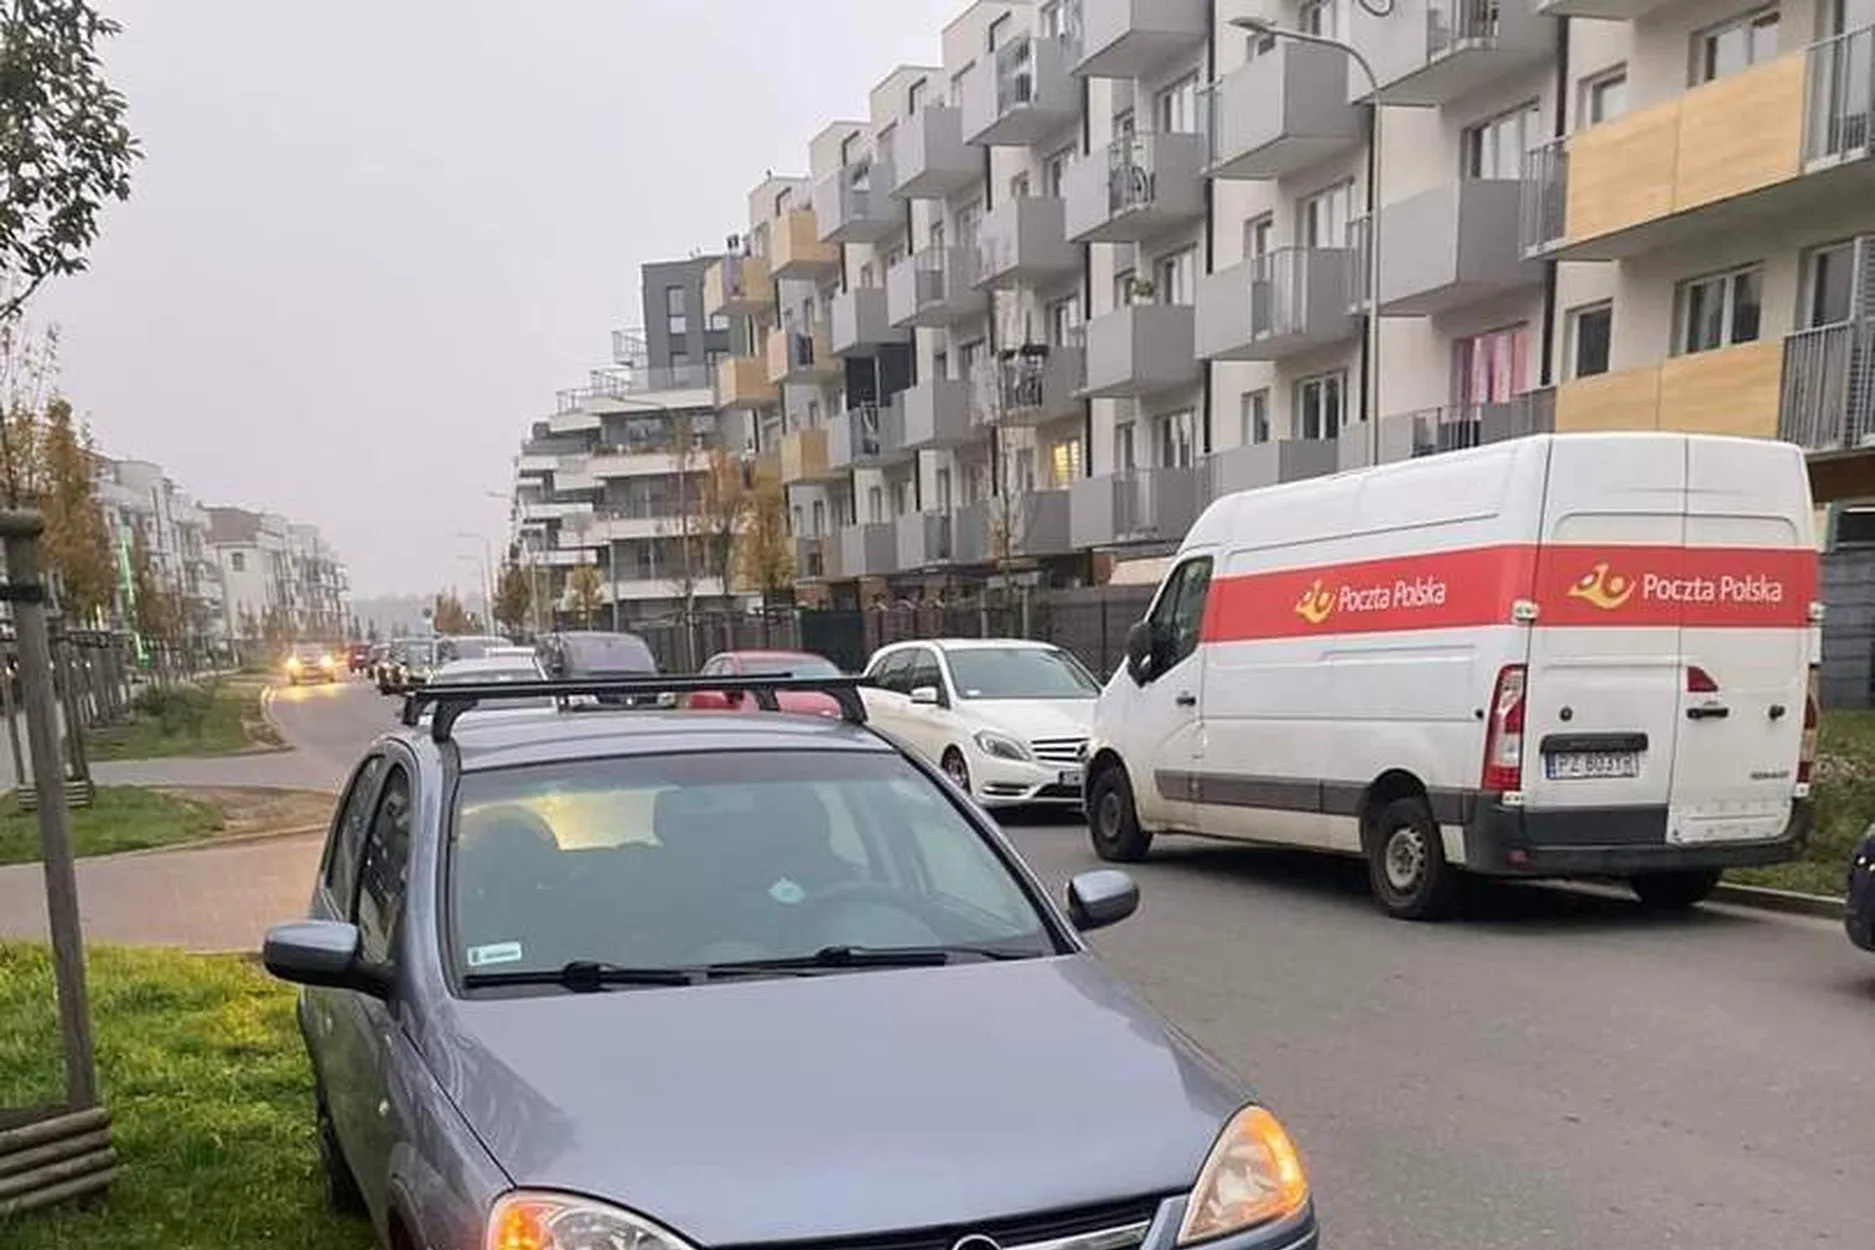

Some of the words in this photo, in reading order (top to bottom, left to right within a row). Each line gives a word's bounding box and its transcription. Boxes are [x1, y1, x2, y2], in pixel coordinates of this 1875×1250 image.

[1338, 585, 1390, 612] Poczta
[1393, 574, 1447, 608] Polska
[1643, 573, 1715, 602] Poczta
[1720, 574, 1783, 602] Polska
